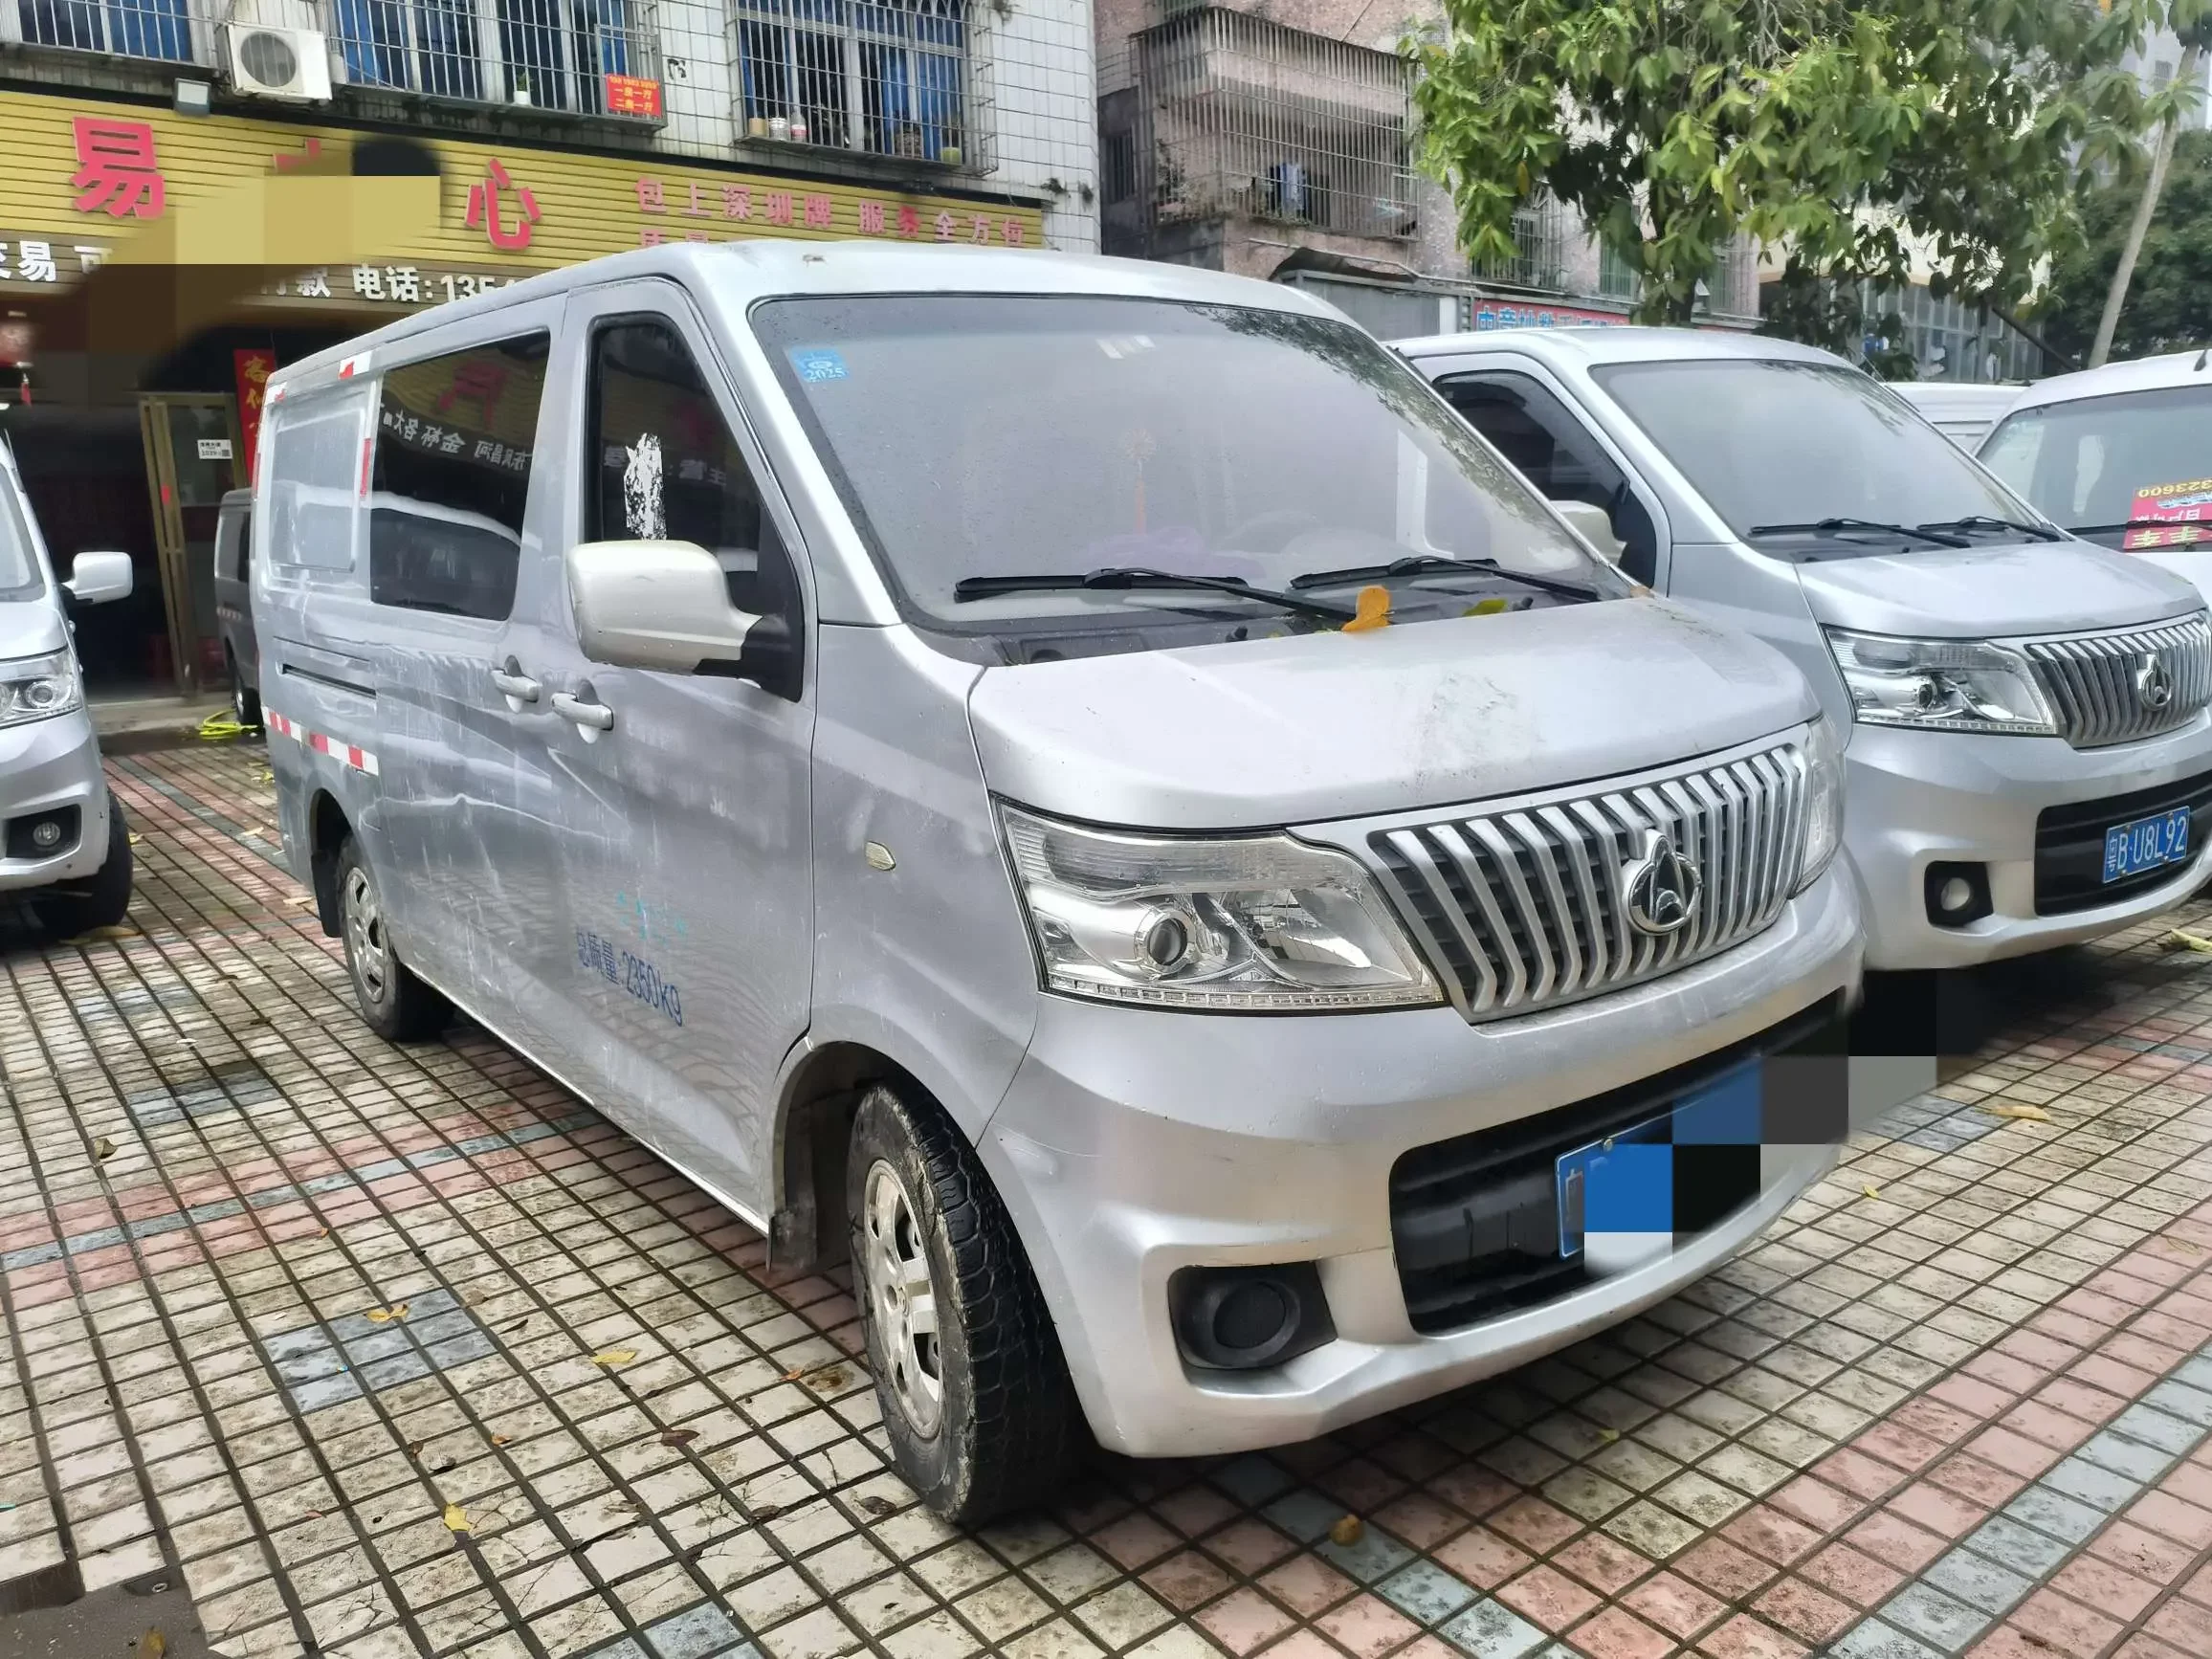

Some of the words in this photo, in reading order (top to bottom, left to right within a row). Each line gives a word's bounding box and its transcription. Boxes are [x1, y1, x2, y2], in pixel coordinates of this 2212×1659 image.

[635, 176, 833, 230] 包上深圳牌
[857, 199, 1026, 247] 服务全方位
